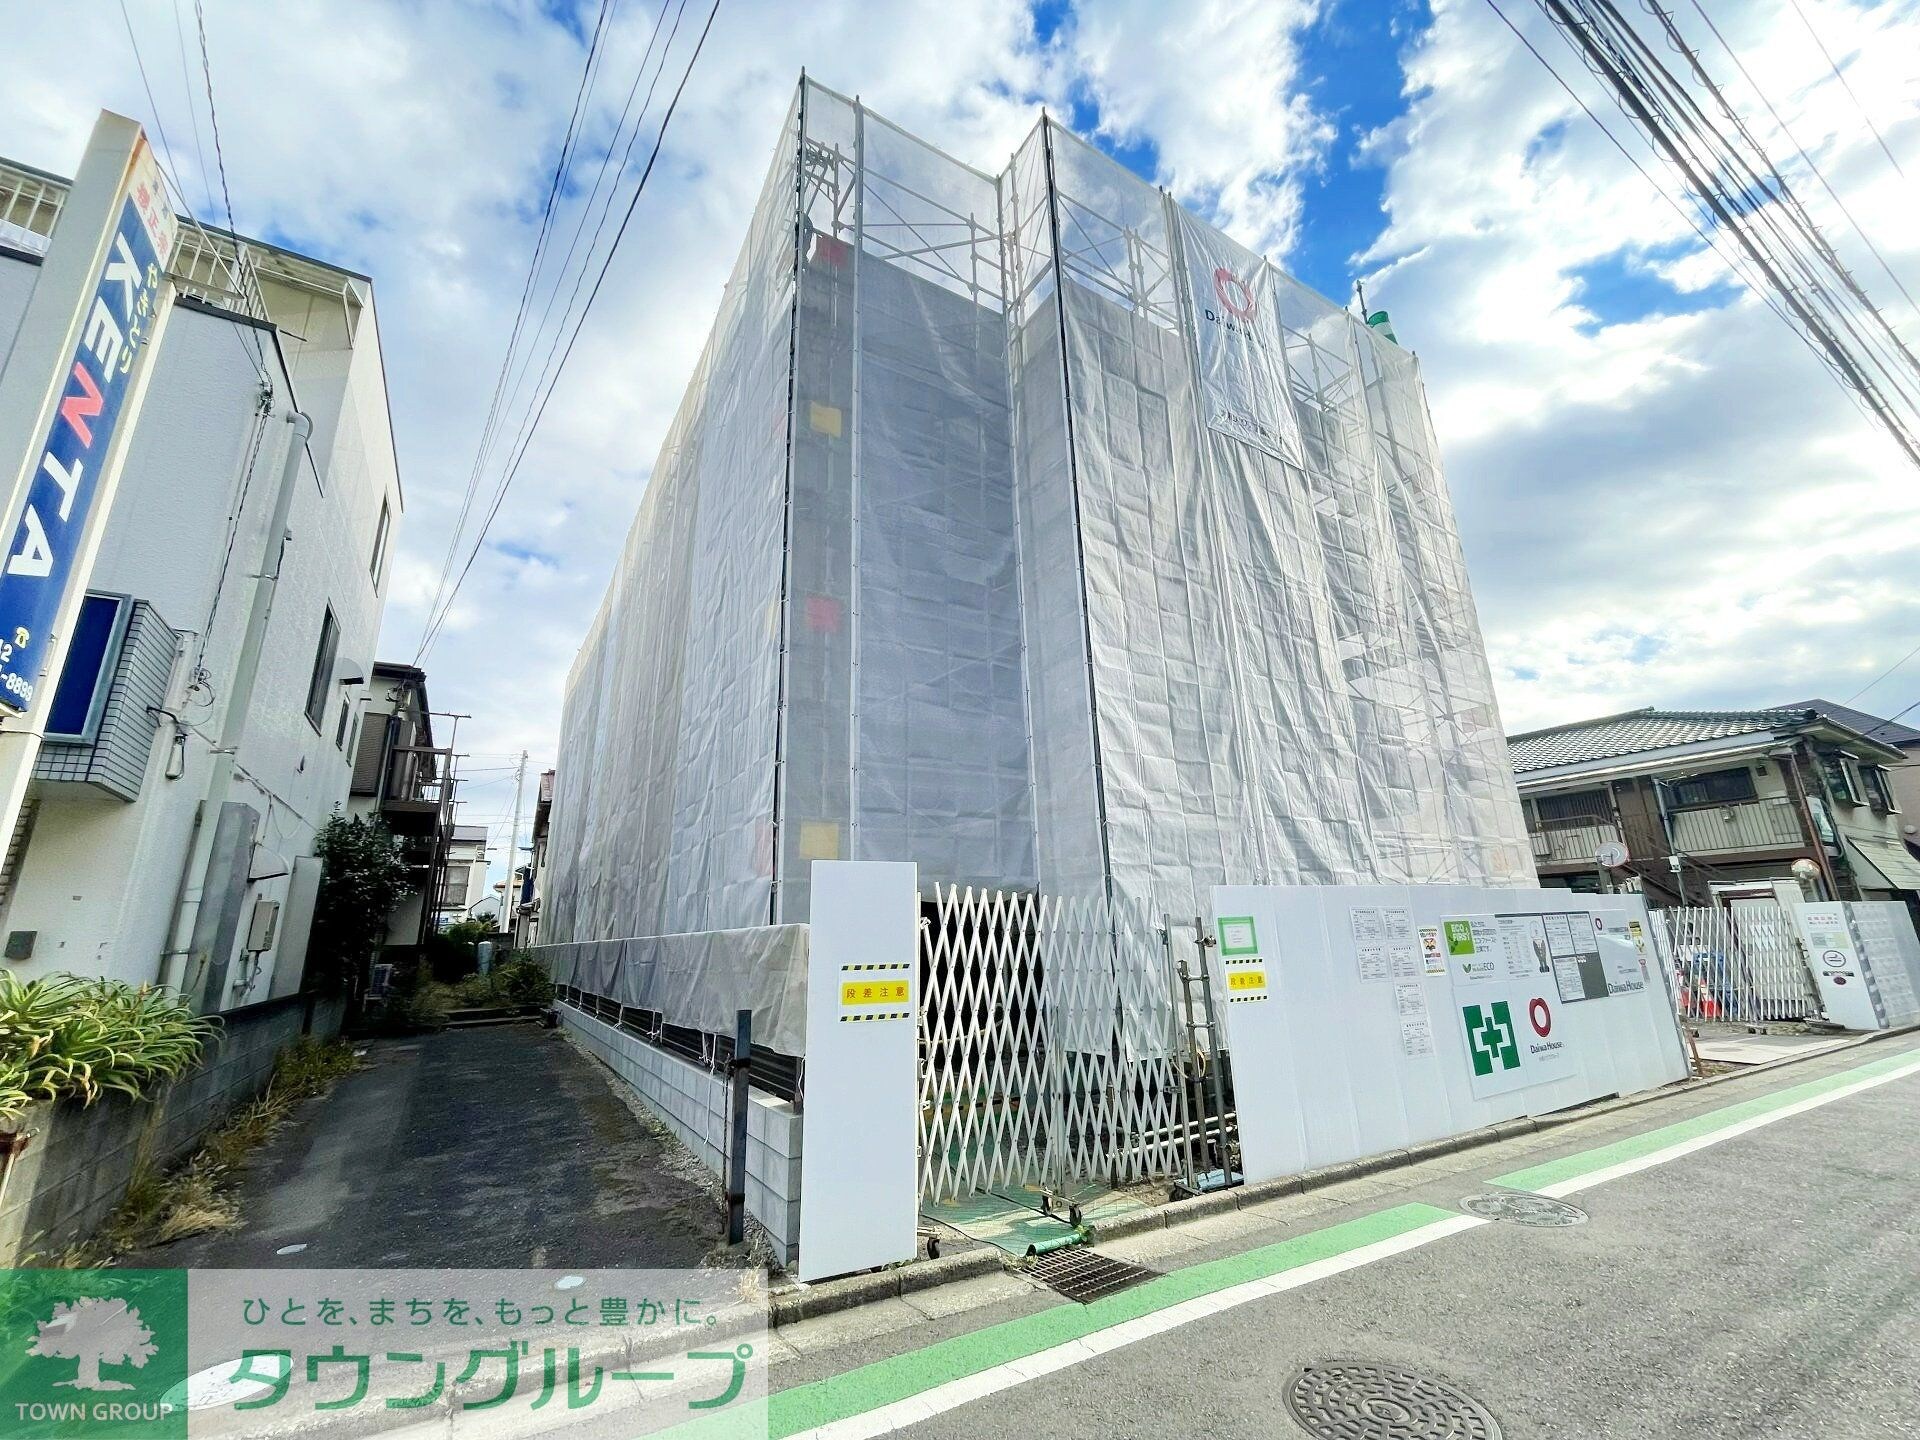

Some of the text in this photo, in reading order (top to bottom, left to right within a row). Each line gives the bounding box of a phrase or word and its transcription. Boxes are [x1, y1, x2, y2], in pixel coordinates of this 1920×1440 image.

[120, 262, 158, 374] やきとり
[7, 231, 143, 576] KENTA
[1451, 924, 1464, 933] ECO
[1452, 932, 1470, 941] FIRST
[846, 986, 905, 999] 段差注意
[1530, 1042, 1547, 1054] Daiwa
